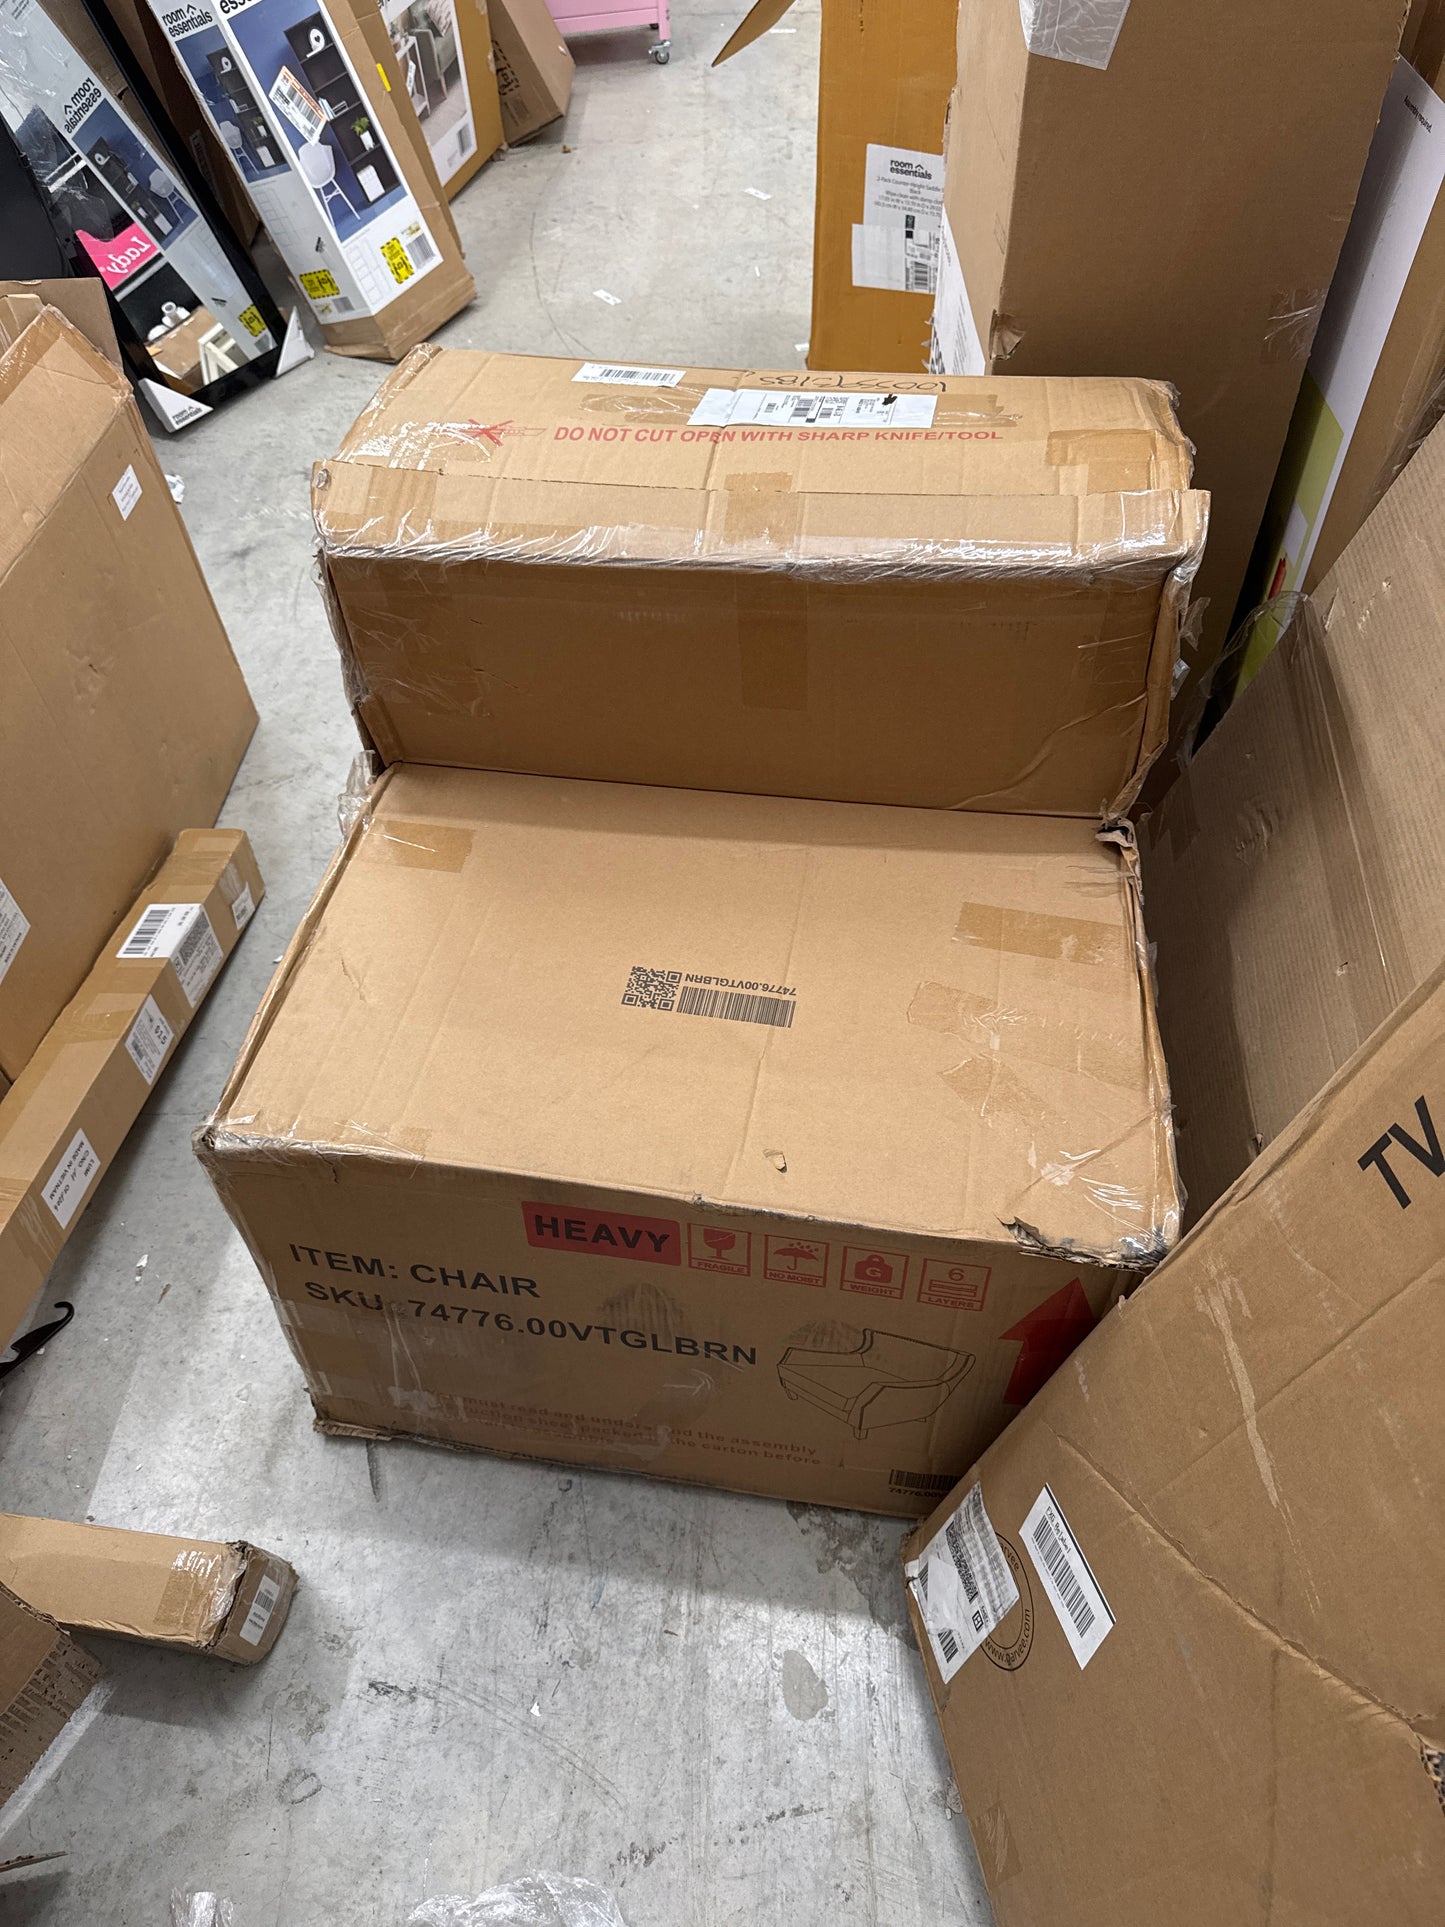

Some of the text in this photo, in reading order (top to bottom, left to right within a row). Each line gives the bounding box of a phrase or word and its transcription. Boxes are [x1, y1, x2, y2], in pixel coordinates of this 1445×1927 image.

[162, 8, 187, 26] room
[169, 9, 213, 37] essentials
[890, 159, 913, 169] room
[890, 167, 932, 180] essentials
[554, 427, 1003, 443] DO NOT CUT OPEN WITH SHARP KNIFE/TOOL
[685, 973, 797, 996] 74776.00VTGLBRN
[1356, 1095, 1445, 1210] TV
[535, 1215, 670, 1252] HEAVY
[289, 1243, 541, 1298] ITEM: CHAIR
[697, 1261, 745, 1274] FRAGILE
[948, 1268, 965, 1281] 6
[787, 1274, 820, 1284] MOIST
[850, 1284, 895, 1296] WEIGHT
[927, 1297, 975, 1309] LAYERS
[407, 1299, 757, 1365] 74776.00VTGLBRN
[698, 1431, 725, 1442] the
[730, 1437, 816, 1456] assembly
[702, 1443, 758, 1457] carton
[764, 1449, 821, 1465] before
